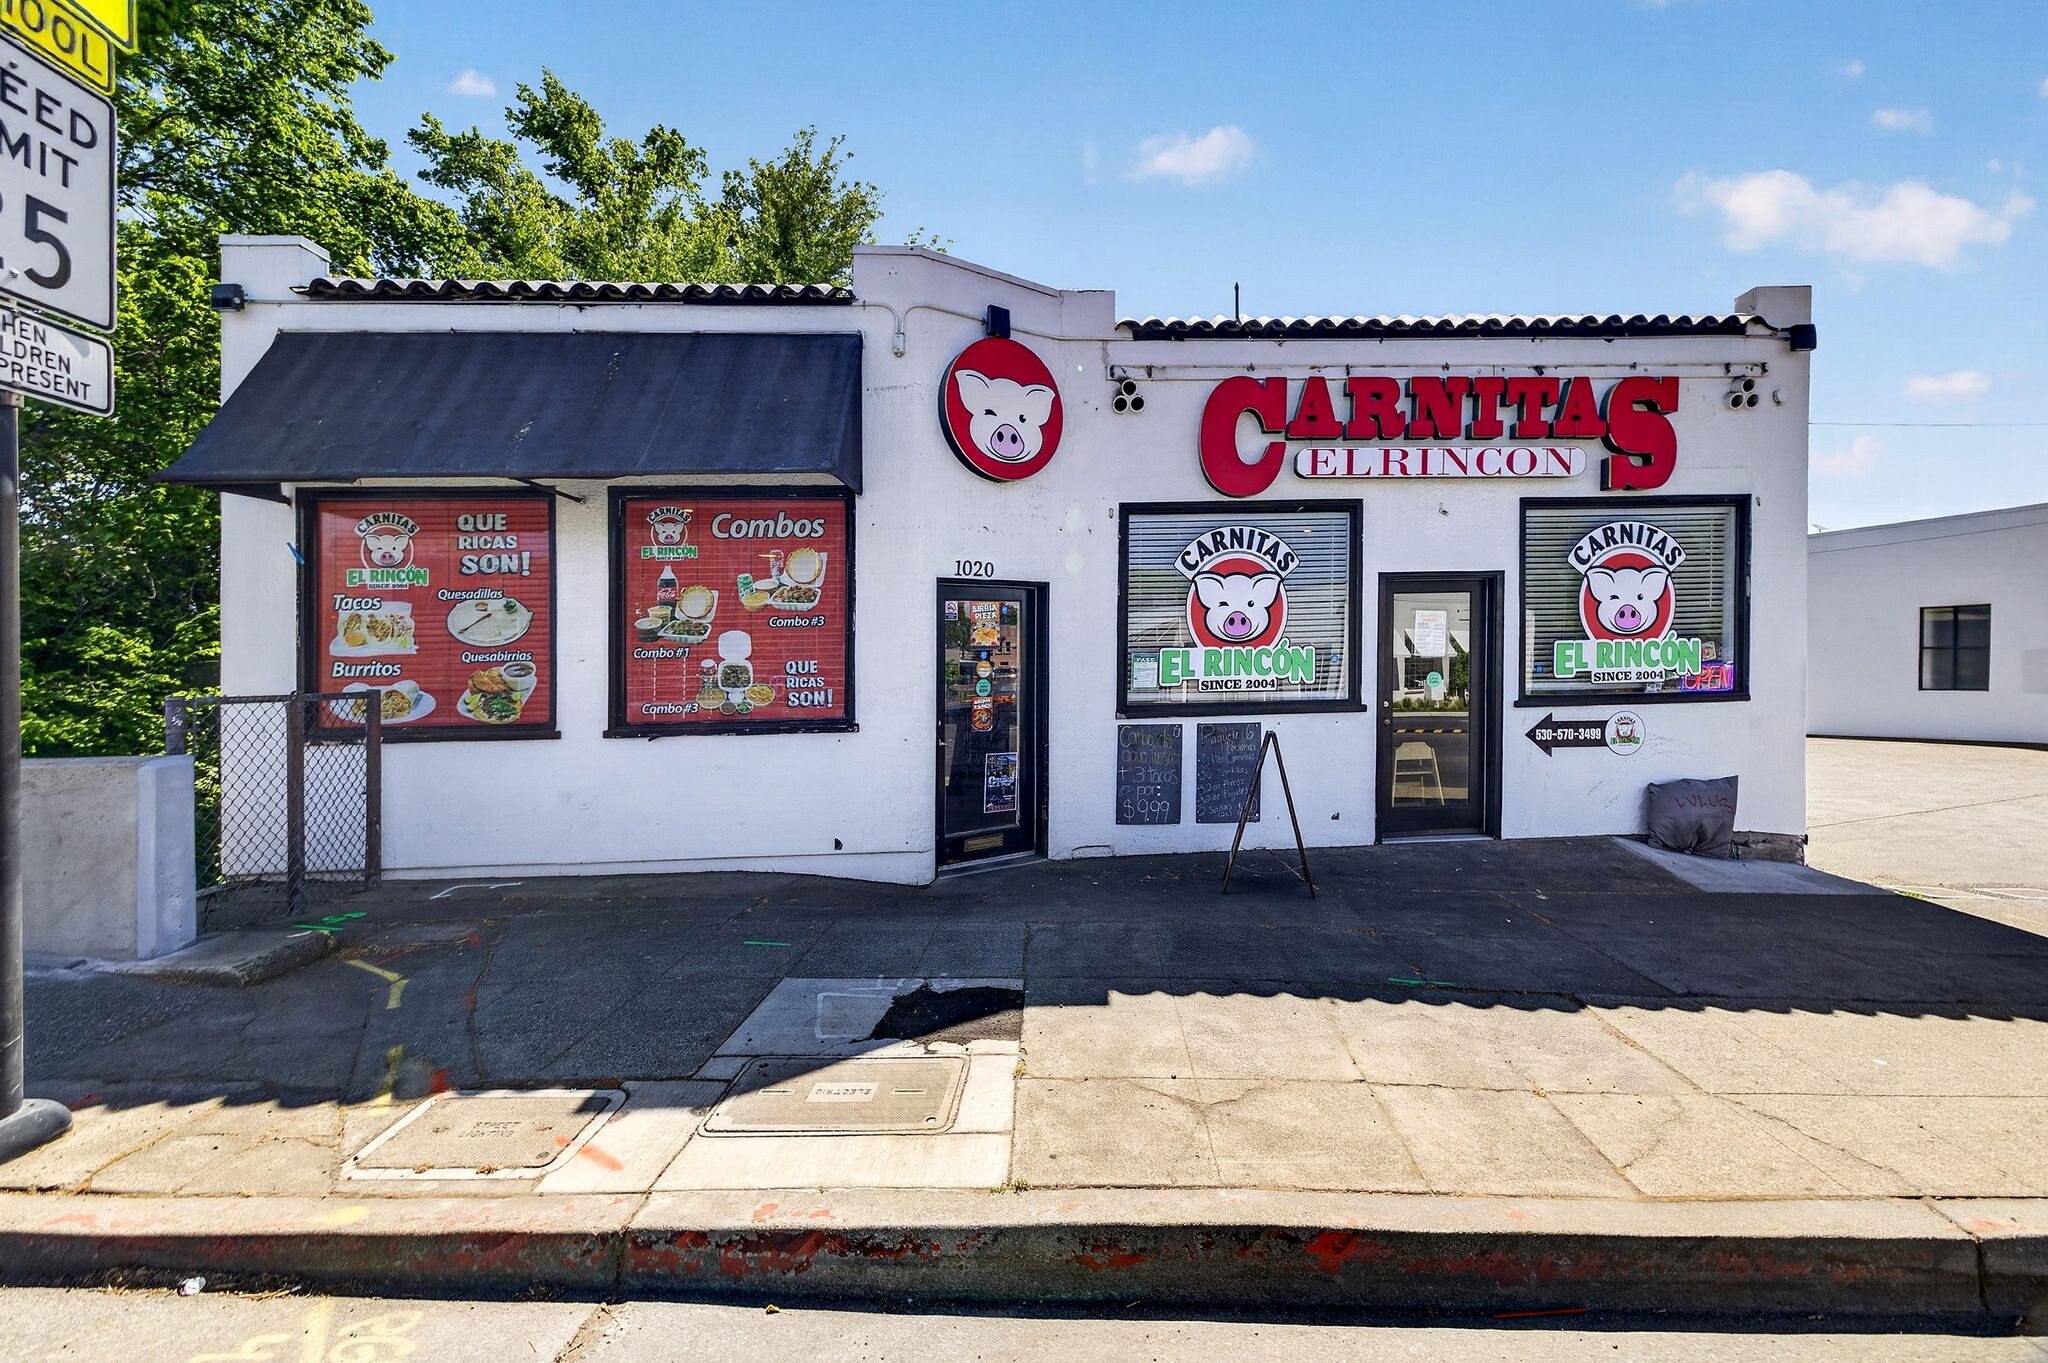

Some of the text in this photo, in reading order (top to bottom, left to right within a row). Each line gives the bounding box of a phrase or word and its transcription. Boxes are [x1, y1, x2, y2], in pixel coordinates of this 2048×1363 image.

[1200, 376, 1679, 496] CARNITAS
[457, 513, 507, 531] QUE
[649, 507, 690, 522] CARNITAS
[357, 513, 417, 534] CARNITAS
[711, 511, 825, 538] Combos
[458, 535, 517, 549] RICAS
[1181, 528, 1295, 571] CARNITAS
[1573, 523, 1682, 565] CARNITAS
[642, 547, 654, 558] EL
[461, 551, 530, 576] SON!
[954, 560, 994, 577] 1020
[347, 565, 428, 586] EL RINCÓN
[333, 594, 382, 610] Tacos
[437, 588, 503, 600] Quesadillas
[769, 616, 825, 627] Combo #3
[461, 651, 532, 663] Quesabirrias
[633, 648, 690, 659] Combo #1
[1556, 631, 1700, 675] EL RINCÓN
[332, 661, 402, 677] Burritos
[785, 660, 818, 675] QUE
[1162, 651, 1195, 684] EL
[1204, 639, 1313, 681] RINCÓN
[786, 676, 825, 688] RICAS
[1593, 670, 1664, 682] SINCE 2004
[1201, 679, 1276, 690] SINCE 2004
[788, 688, 833, 707] SON!
[642, 703, 699, 714] Combo #3
[1535, 728, 1602, 740] 530-570-3499
